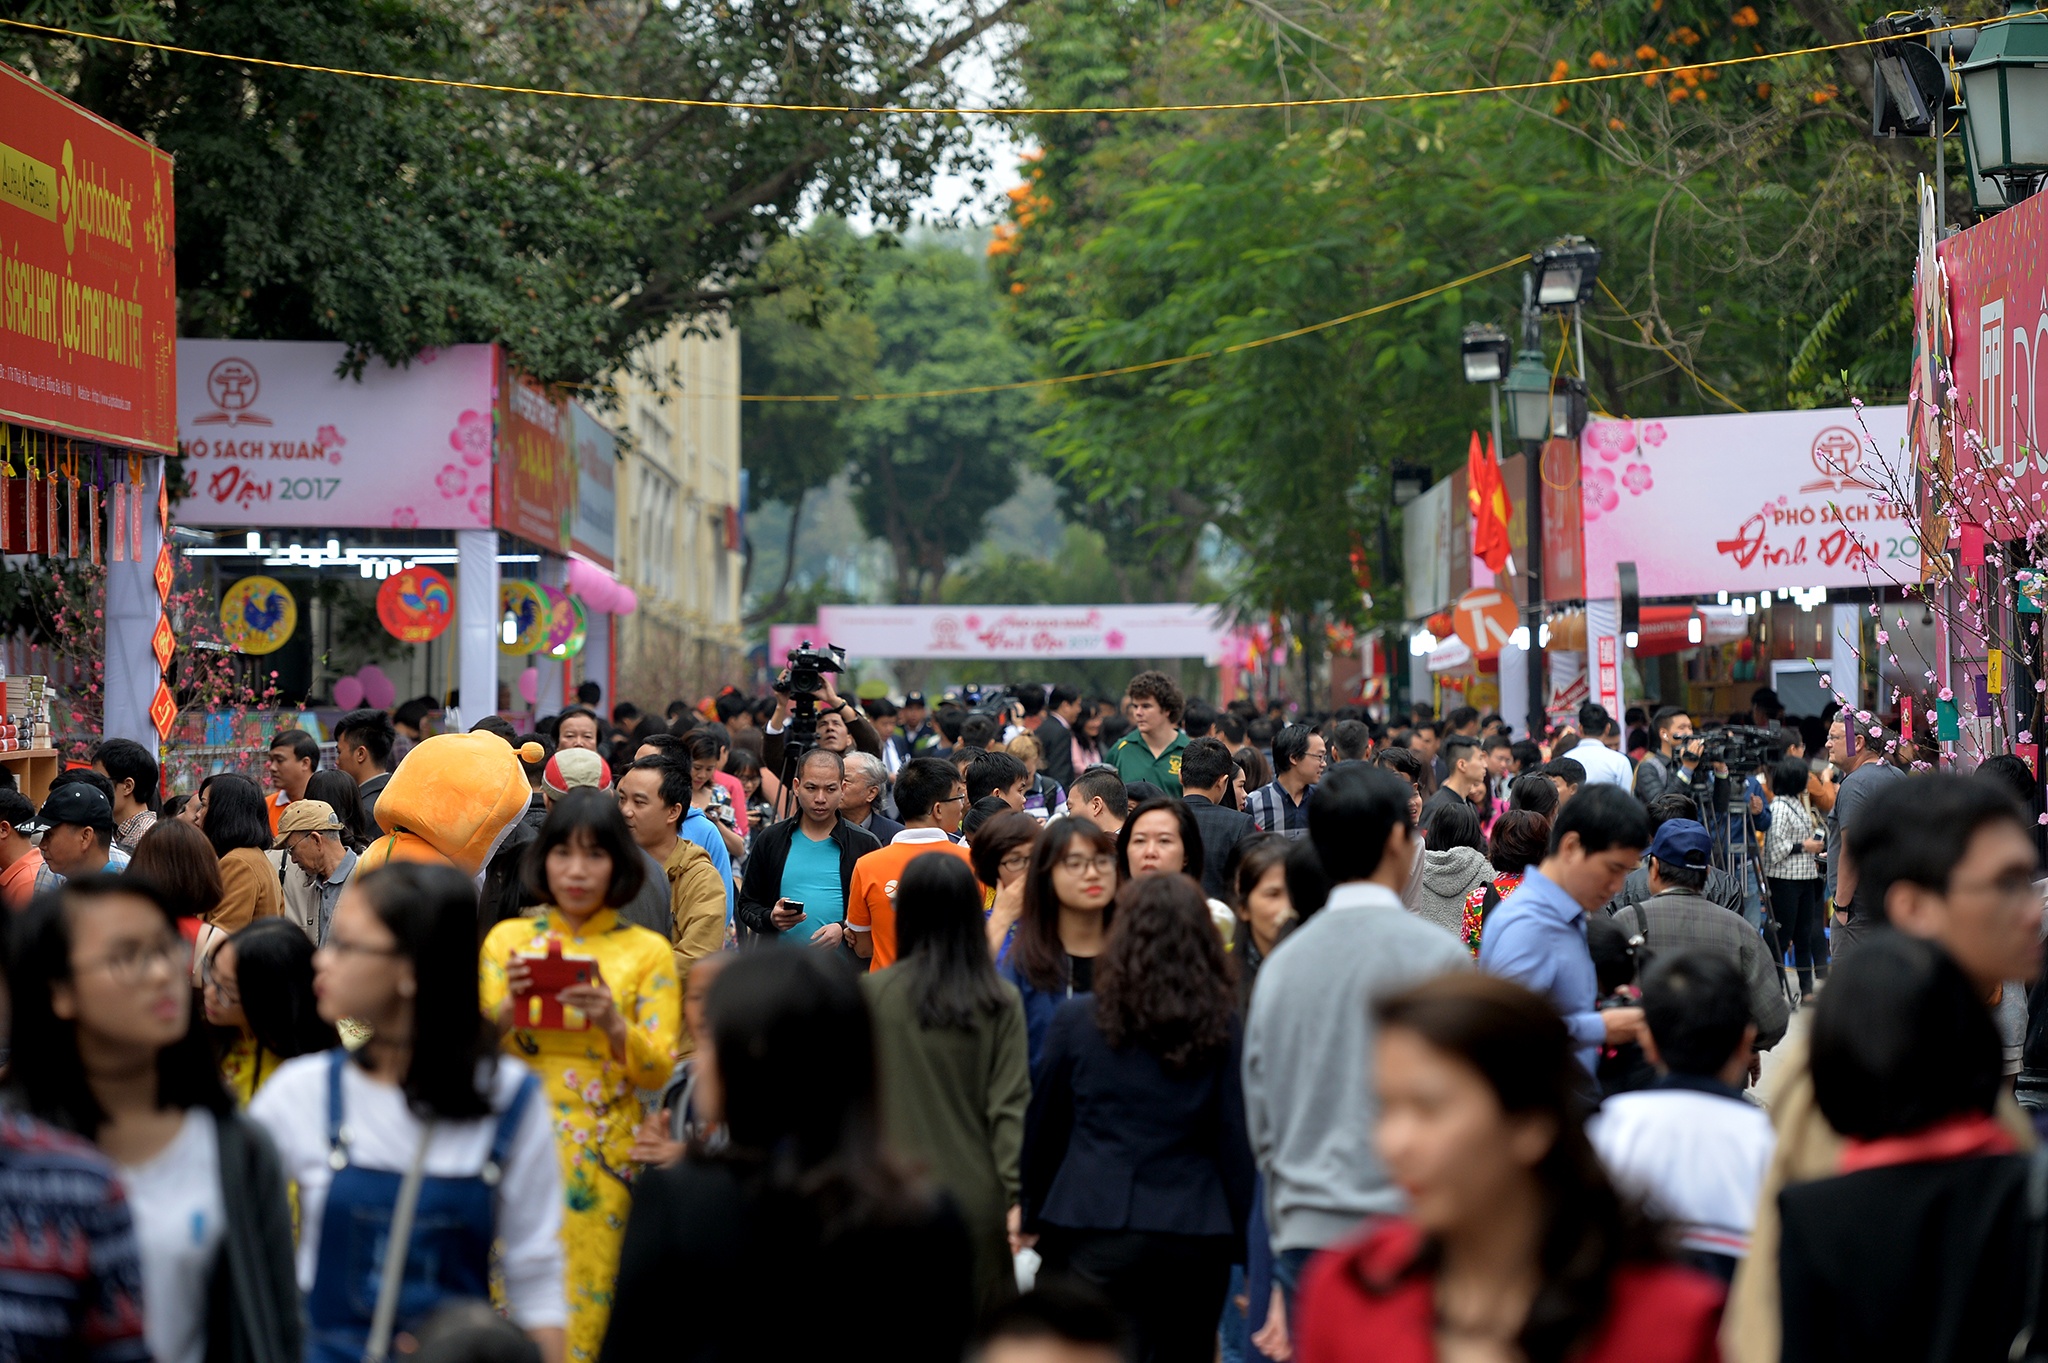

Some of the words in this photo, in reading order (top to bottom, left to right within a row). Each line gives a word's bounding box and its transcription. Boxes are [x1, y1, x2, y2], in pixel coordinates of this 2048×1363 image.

[77, 159, 132, 253] alphabooks
[5, 240, 35, 338] SÁCH
[278, 476, 342, 501] 2017
